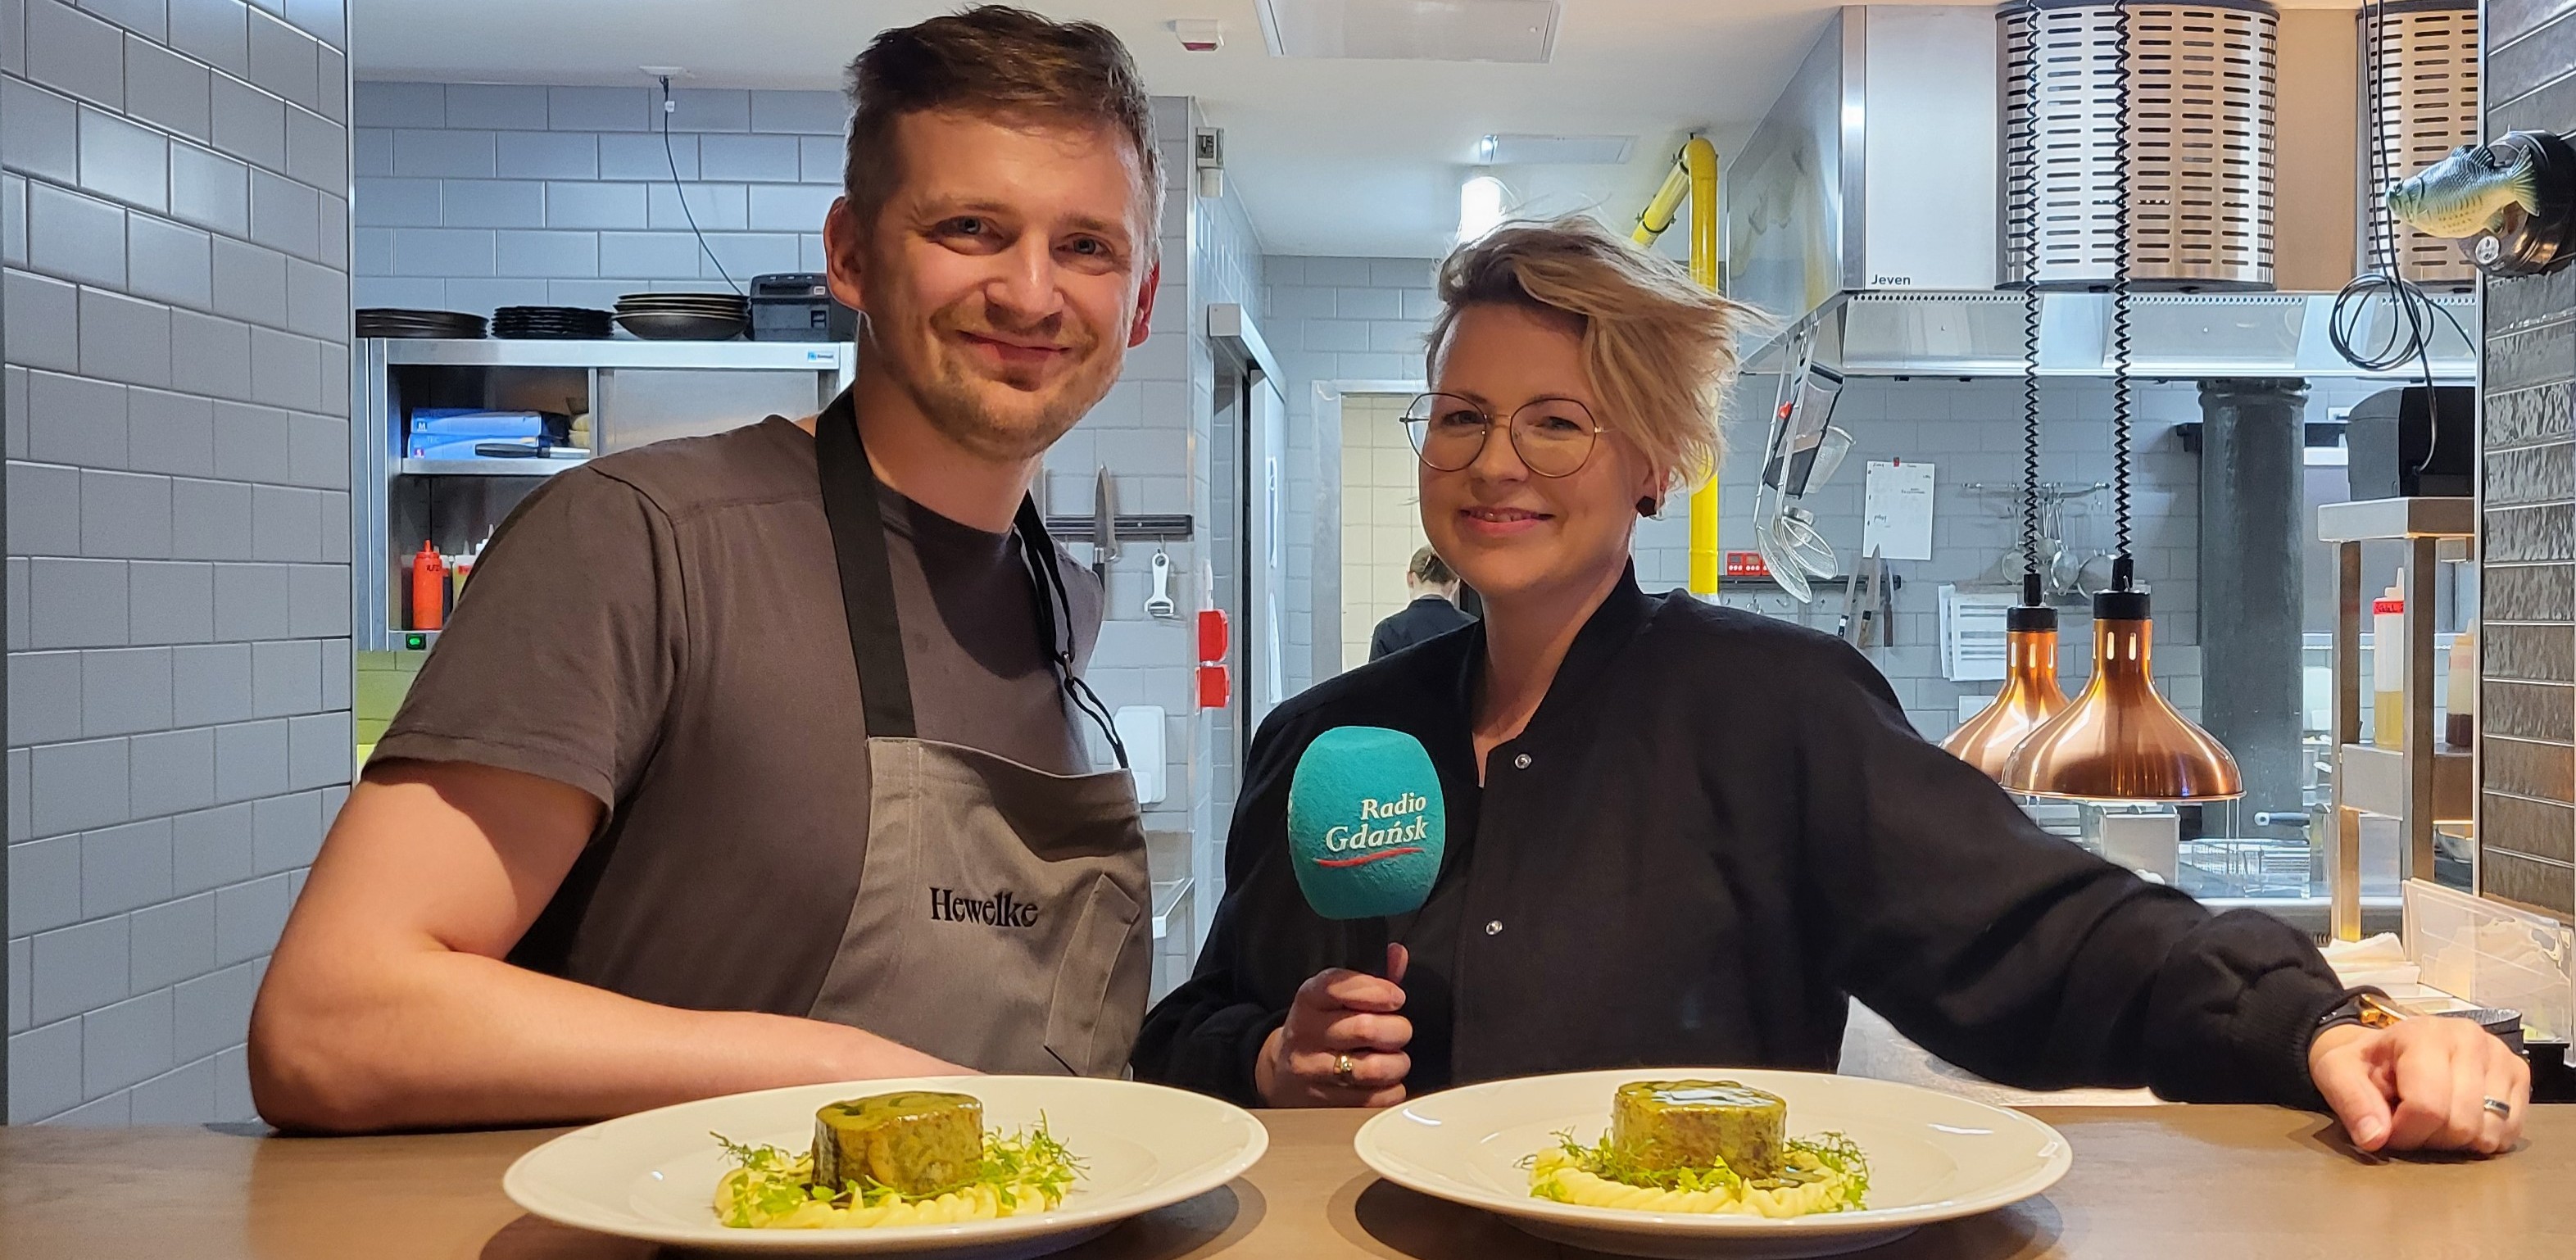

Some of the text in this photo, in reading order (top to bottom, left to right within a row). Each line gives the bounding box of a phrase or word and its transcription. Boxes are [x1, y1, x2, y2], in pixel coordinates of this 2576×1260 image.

[1871, 274, 1911, 285] Jeven
[1360, 791, 1426, 821] Radio
[1326, 815, 1429, 853] Gdańsk
[929, 886, 1038, 927] Hewelke
